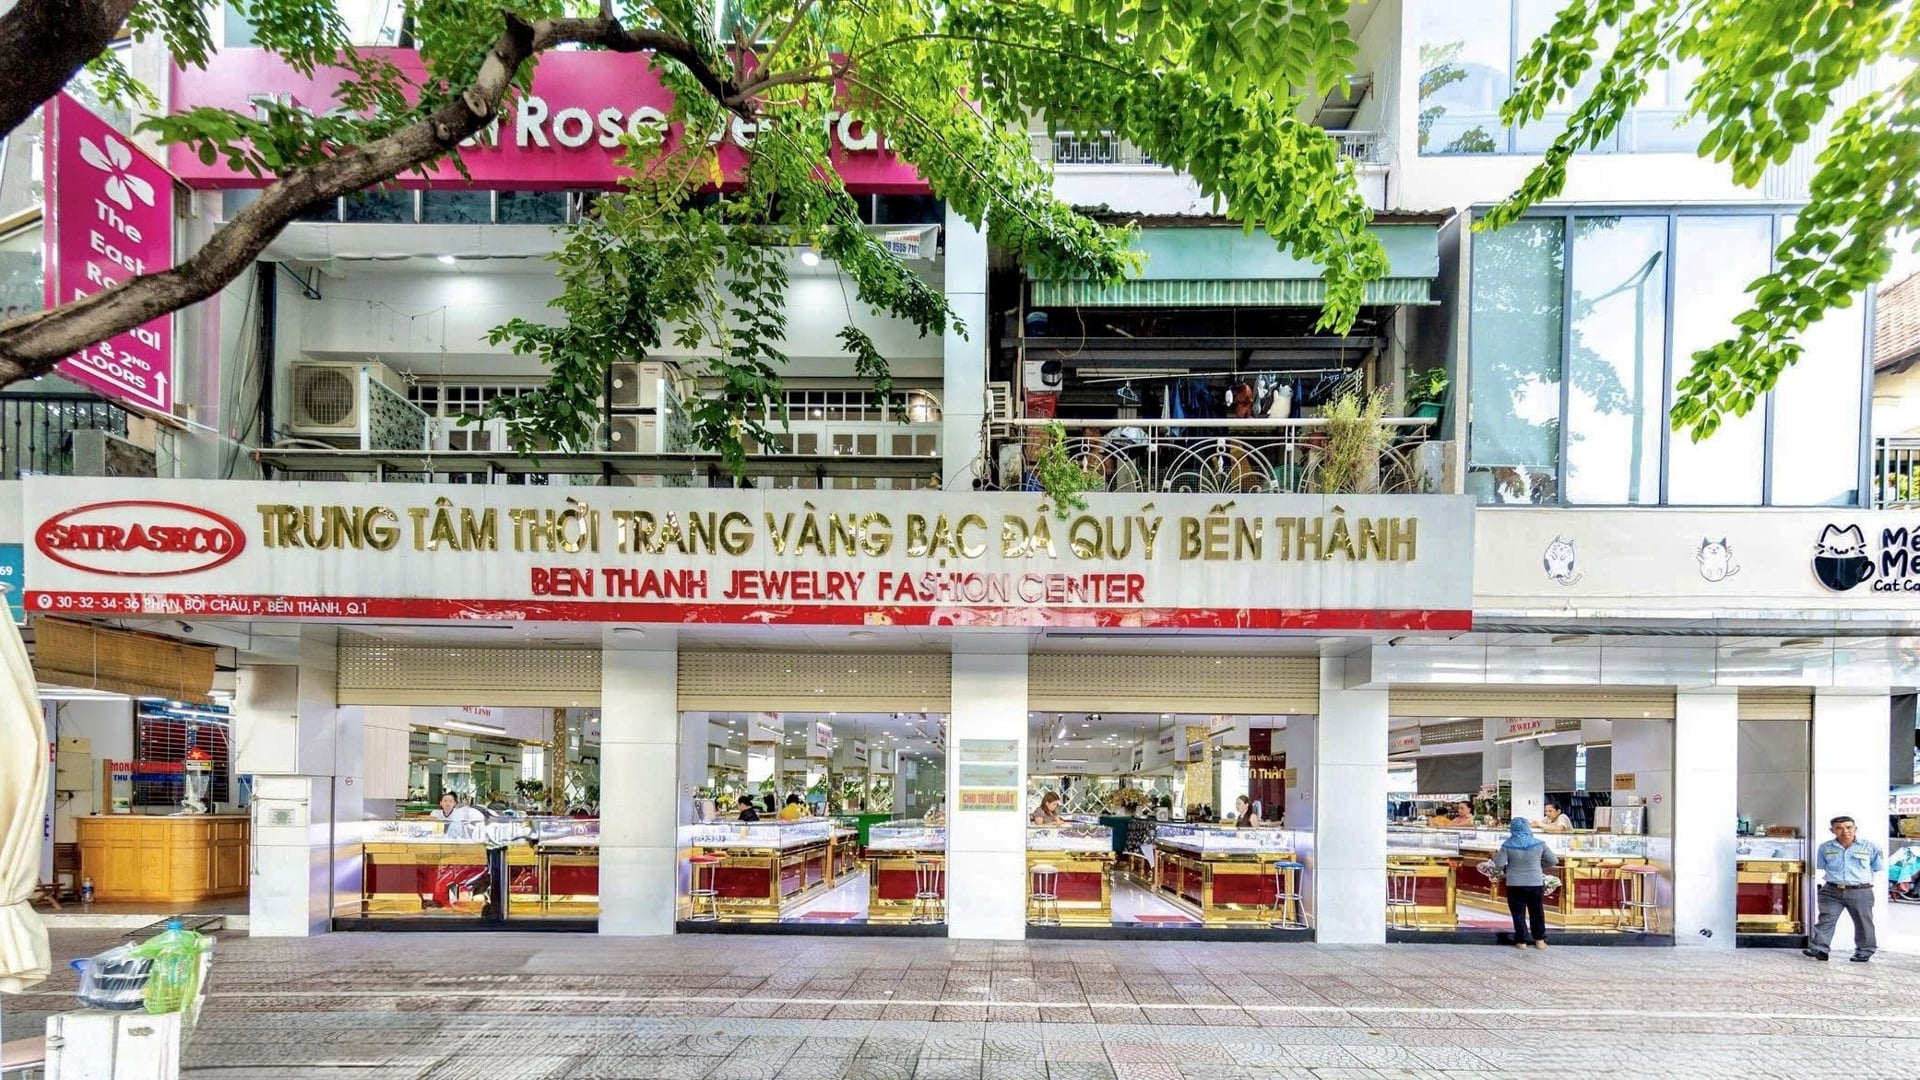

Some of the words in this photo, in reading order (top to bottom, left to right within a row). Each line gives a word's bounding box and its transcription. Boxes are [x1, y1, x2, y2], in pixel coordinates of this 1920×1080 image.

[516, 97, 669, 148] Rose
[95, 198, 142, 244] The
[90, 229, 145, 277] East
[78, 349, 147, 389] LOORS
[99, 341, 116, 359] &
[120, 351, 152, 372] 2ND
[47, 523, 231, 554] SATRASECO
[256, 504, 401, 550] TRUNG
[408, 496, 499, 552] TÂM
[508, 496, 600, 554] THỜI
[612, 510, 755, 556] TRANG
[764, 500, 894, 557] VÀNG
[906, 513, 988, 568] BẠC
[1002, 503, 1058, 560] ĐÁ
[1069, 502, 1164, 560] QUÝ
[1179, 500, 1263, 561] BẾN
[1275, 504, 1418, 561] THÀNH
[530, 567, 594, 597] BEN
[601, 568, 708, 598] THANH
[723, 570, 865, 600] JEWELRY
[878, 571, 1010, 603] FASHION
[1017, 573, 1145, 603] CENTER
[1874, 578, 1900, 591] Cat
[184, 595, 205, 613] BỘI
[210, 596, 250, 613] CHÂU,
[253, 600, 264, 612] P.
[267, 596, 293, 613] BẾN
[297, 599, 342, 615] THÀNH,
[346, 602, 367, 615] Q.1
[1509, 720, 1542, 733] JEWELRY
[1258, 765, 1286, 779] THÀN
